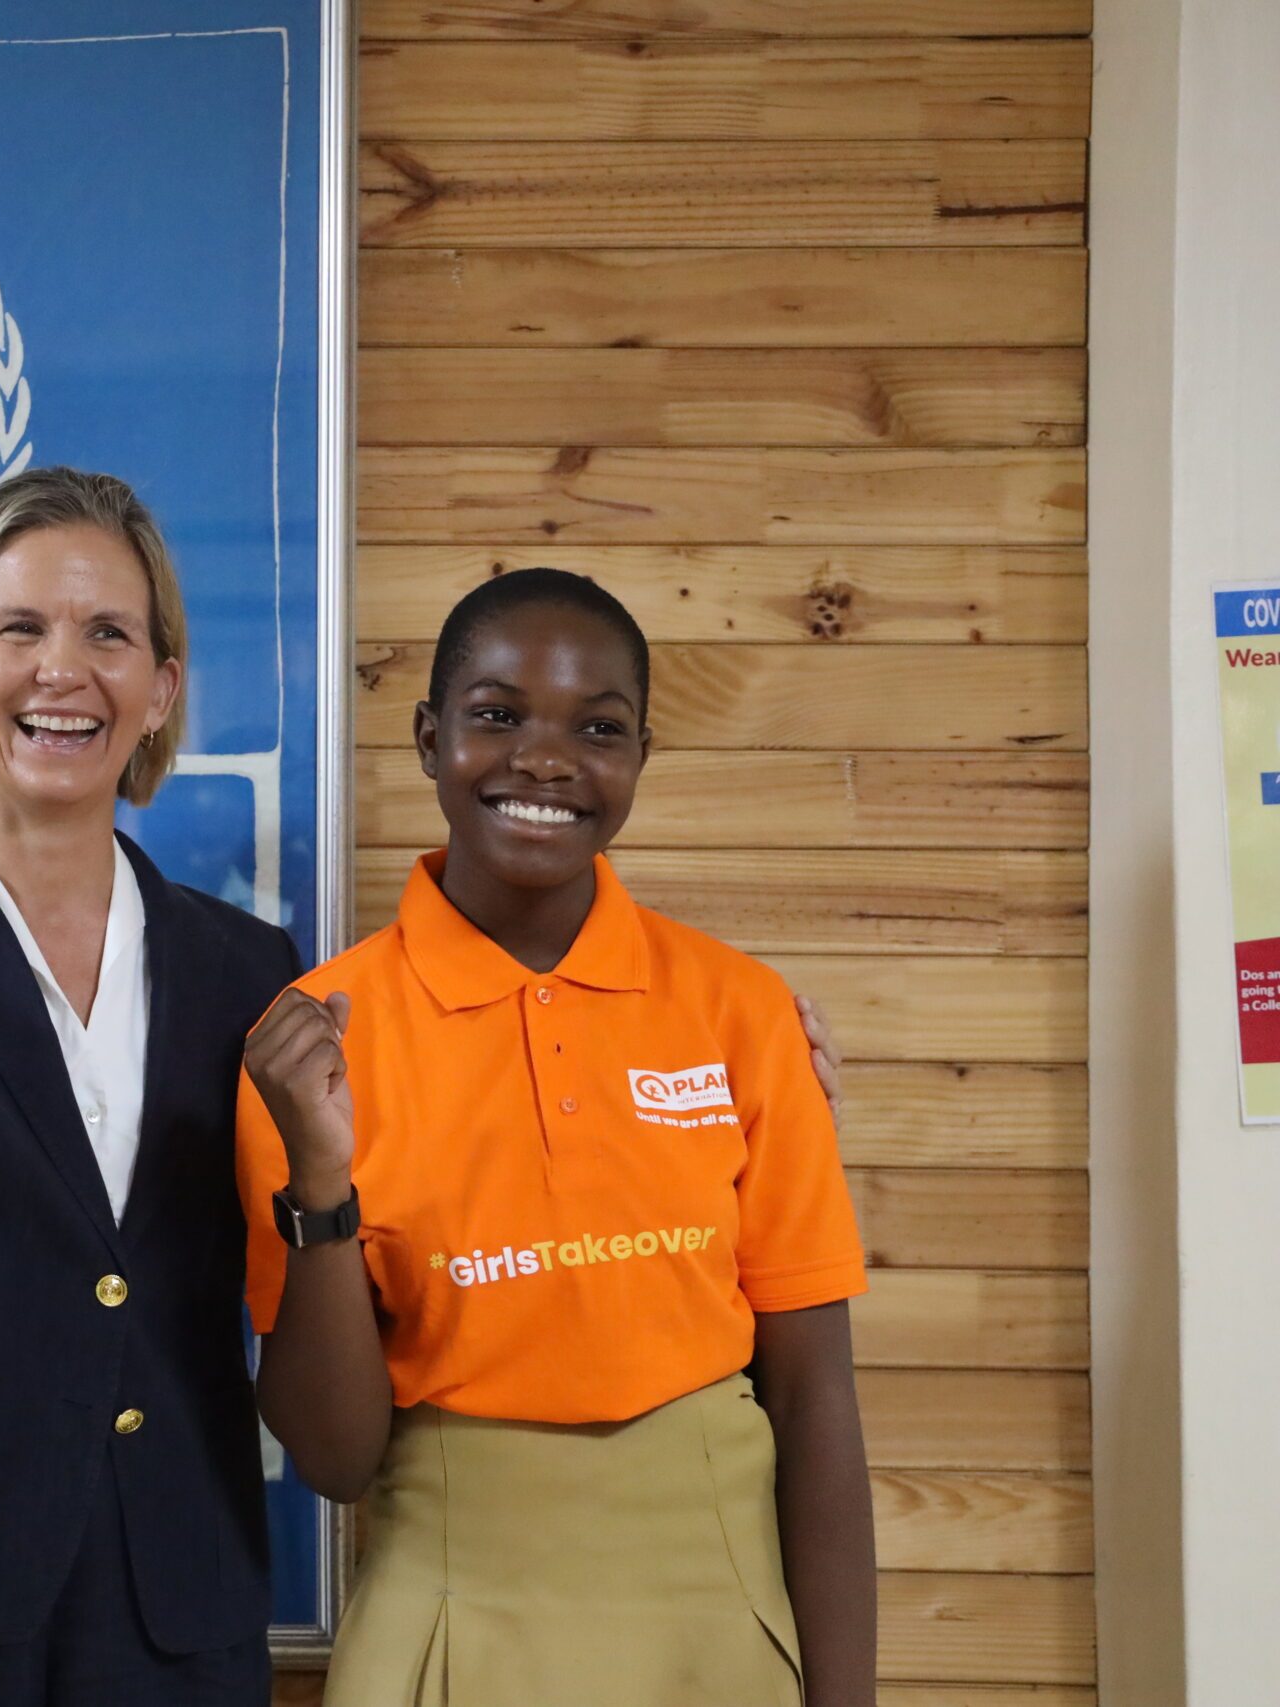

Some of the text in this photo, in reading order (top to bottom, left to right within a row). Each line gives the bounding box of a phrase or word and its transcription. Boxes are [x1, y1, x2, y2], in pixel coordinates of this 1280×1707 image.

[1240, 969, 1265, 981] Dos
[1241, 984, 1275, 999] going
[1242, 1003, 1250, 1011] a
[635, 1111, 662, 1124] Until
[662, 1116, 679, 1127] we
[680, 1118, 699, 1129] are
[701, 1113, 717, 1126] all
[429, 1226, 716, 1287] #GirlsTakeover
